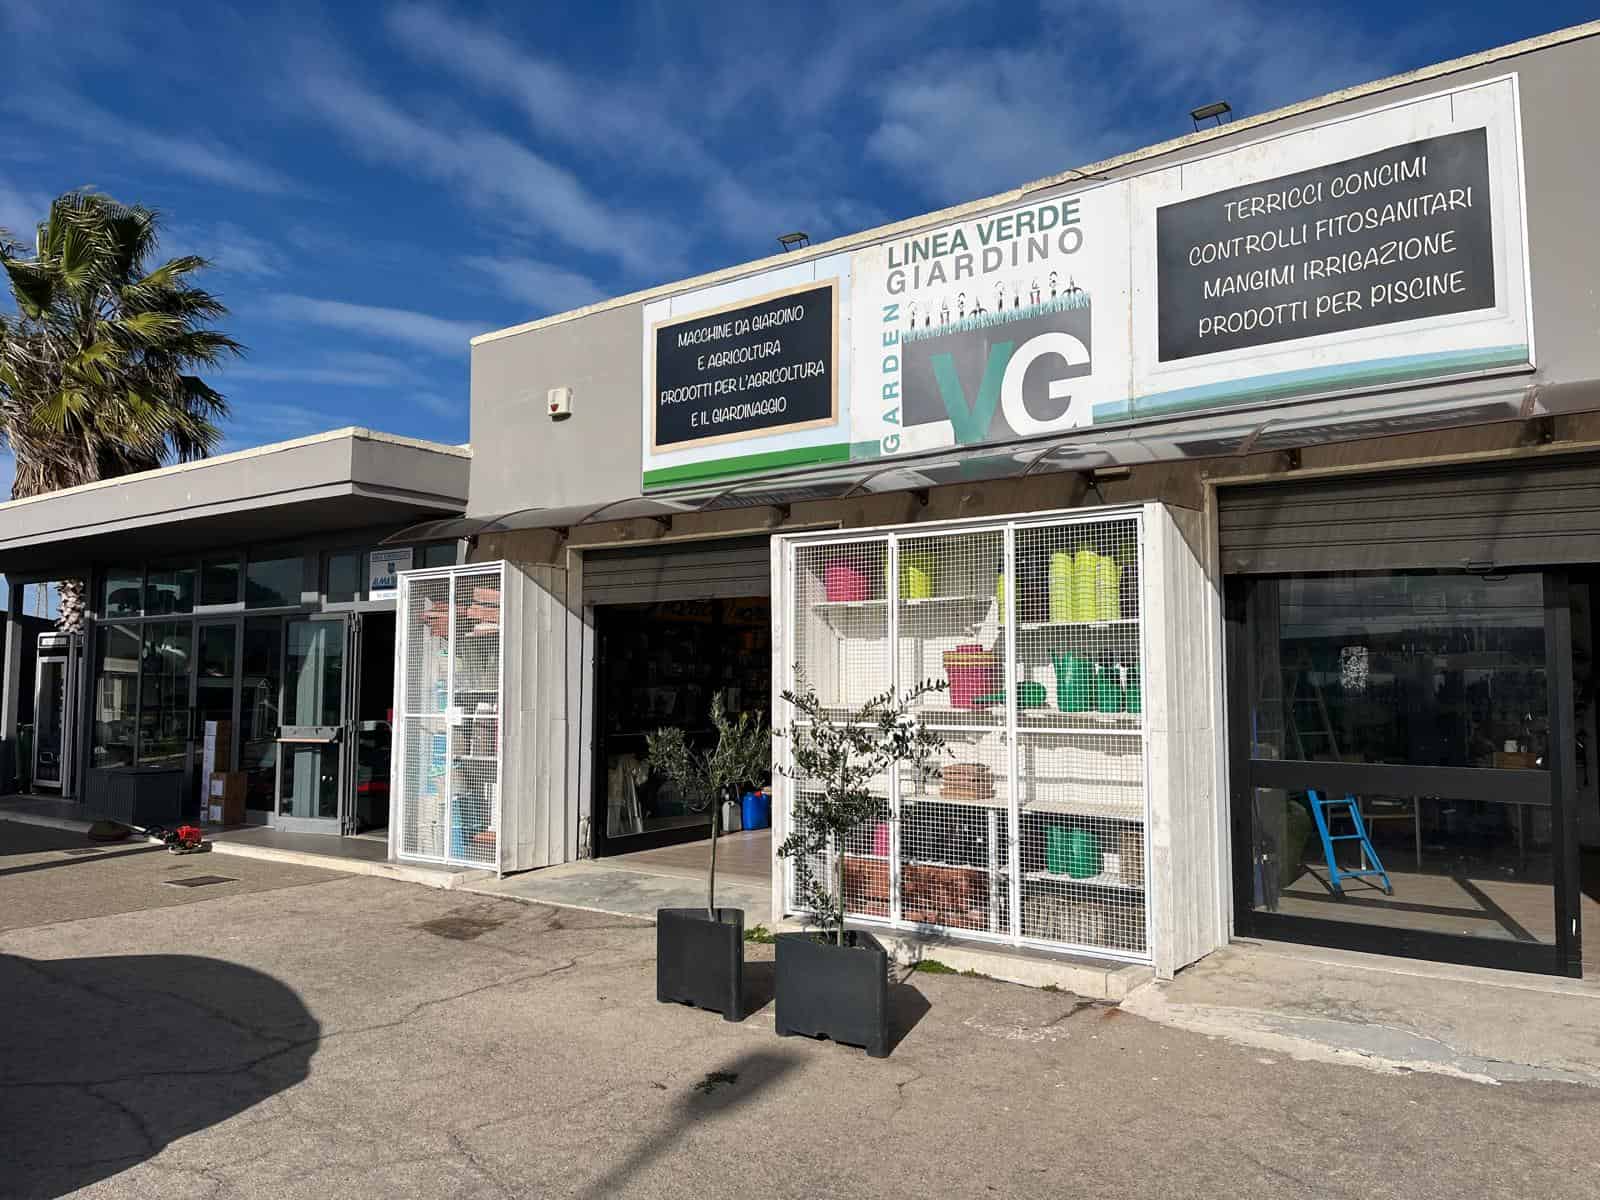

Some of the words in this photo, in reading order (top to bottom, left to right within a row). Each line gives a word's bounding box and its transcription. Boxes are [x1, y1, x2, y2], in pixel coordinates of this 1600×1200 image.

[1224, 183, 1322, 223] TERRICCI
[1331, 155, 1427, 199] CONCIMI
[888, 228, 969, 269] LINEA
[976, 198, 1081, 246] VERDE
[1188, 224, 1307, 266] CONTROLLI
[1315, 186, 1473, 241] FITOSANITARI
[886, 227, 1084, 295] GIARDINO
[1203, 264, 1295, 300] MANGIMI
[1304, 230, 1457, 281] IRRIGAZIONE
[678, 321, 733, 348] MACCHINE
[735, 319, 749, 336] DA
[752, 305, 804, 331] GIARDINO
[1199, 301, 1308, 338] PRODOTTI
[1316, 290, 1362, 318] PER
[1371, 270, 1467, 307] PISCINE
[660, 382, 713, 406] PRODOTTI
[714, 377, 737, 396] PER
[739, 359, 825, 391] L'AGRICOLTURA
[697, 355, 705, 371] E
[707, 339, 781, 369] AGRICOLTURA
[882, 303, 900, 454] GARDEN
[929, 331, 1092, 446] VG
[691, 411, 699, 427] E
[700, 409, 710, 425] IL
[712, 396, 787, 424] GIARDINAGGIO
